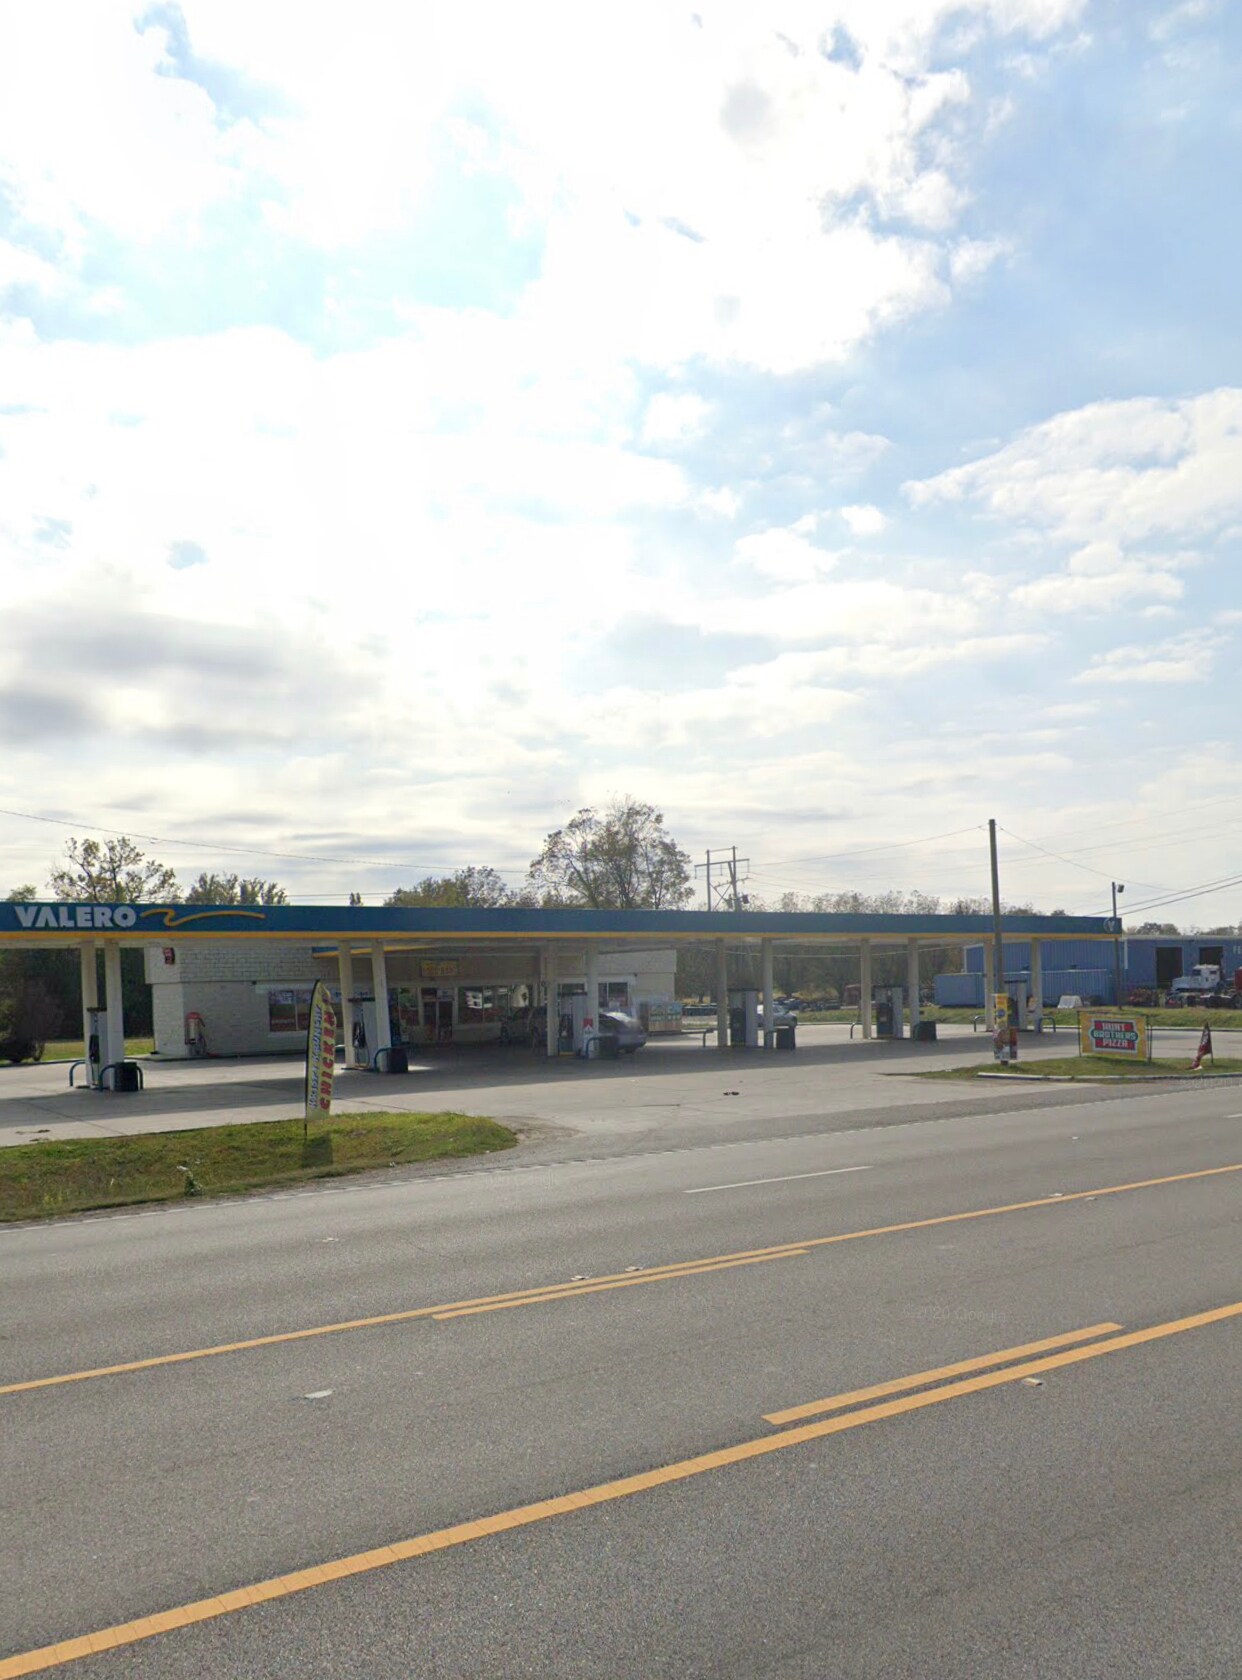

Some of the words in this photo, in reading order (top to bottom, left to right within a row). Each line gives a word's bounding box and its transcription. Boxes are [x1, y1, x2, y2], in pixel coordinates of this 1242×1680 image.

[14, 905, 136, 928] VALERO
[1102, 1038, 1129, 1048] PIZZA
[319, 1010, 335, 1110] CHICKEN
